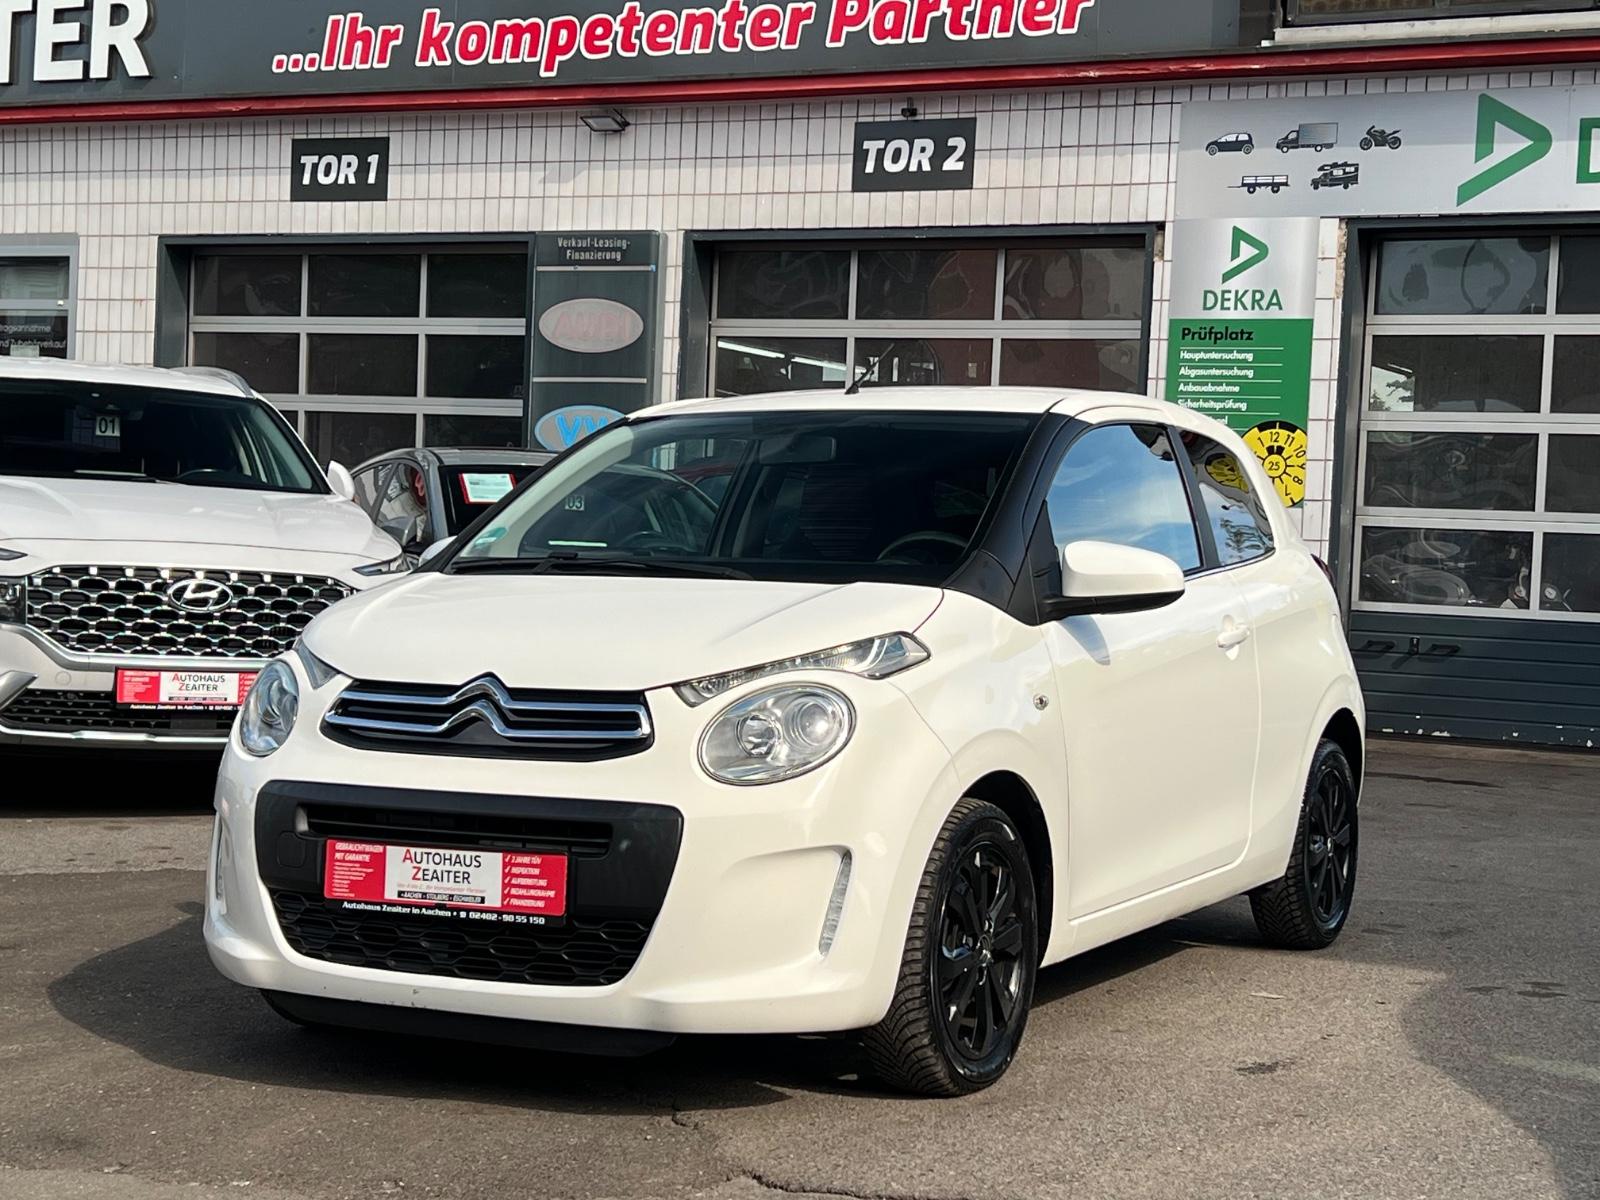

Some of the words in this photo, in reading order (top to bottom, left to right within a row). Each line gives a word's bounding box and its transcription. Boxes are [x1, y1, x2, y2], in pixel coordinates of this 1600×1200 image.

[414, 0, 816, 78] kompetenter
[825, 0, 1097, 49] Partner
[862, 139, 935, 174] TOR
[941, 136, 967, 171] 2
[300, 154, 360, 186] TOR
[366, 153, 379, 185] 1
[566, 249, 622, 262] Finanzierung
[1202, 289, 1284, 311] DEKRA
[1181, 326, 1254, 344] Prüfplatz
[1179, 350, 1254, 362] Hauptuntersuchung
[1178, 366, 1254, 378] Abgasuntersuchung
[1178, 382, 1240, 393] Anbauabnahme
[1177, 399, 1248, 411] Sicherheitsprüfung
[98, 417, 118, 435] 01
[1269, 431, 1280, 443] 12
[1284, 434, 1295, 448] 11
[1293, 444, 1306, 459] 10
[1268, 461, 1280, 471] 25
[1292, 475, 1304, 486] 8
[567, 496, 583, 510] 03
[172, 673, 226, 683] AUTOHAUS
[179, 683, 218, 692] ZEAITER
[402, 848, 482, 869] AUTOHAUS
[411, 866, 471, 884] ZEAITER
[342, 901, 381, 911] Autohaus
[382, 904, 411, 913] Zeaiter
[412, 906, 420, 914] in
[421, 907, 451, 917] Aachen
[529, 916, 546, 925] 150
